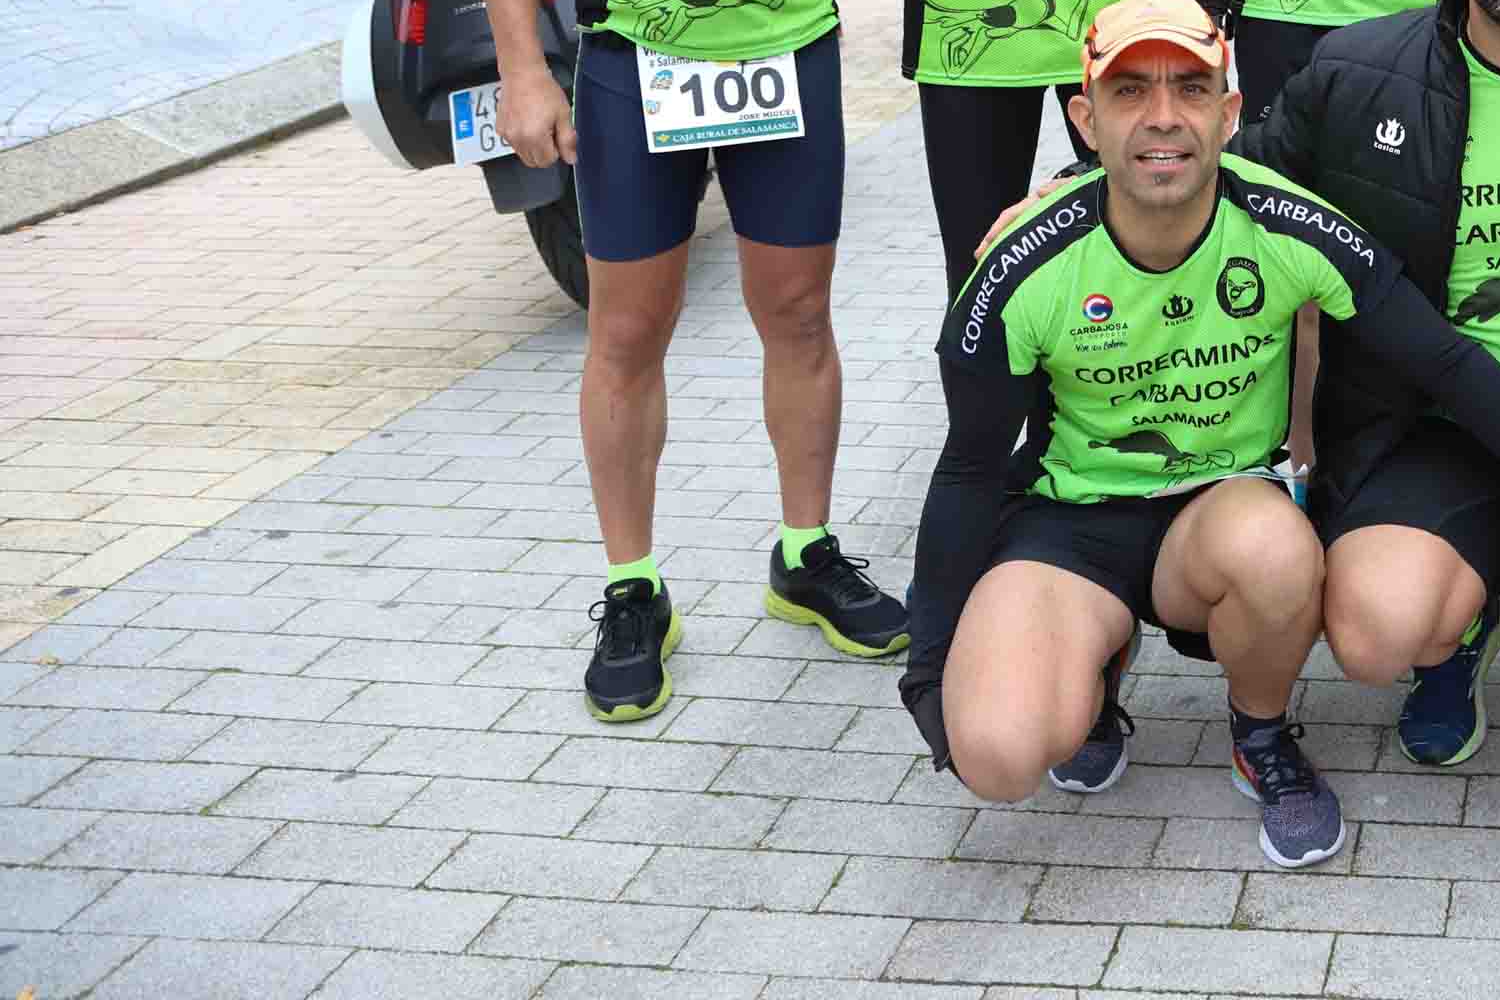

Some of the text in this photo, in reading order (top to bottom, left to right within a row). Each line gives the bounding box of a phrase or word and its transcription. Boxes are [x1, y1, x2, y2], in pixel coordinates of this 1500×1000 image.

[657, 56, 706, 67] Salama
[680, 67, 785, 117] 100
[672, 134, 694, 143] CAJA
[696, 131, 725, 141] RURAL
[739, 121, 798, 134] SALAMANCA
[1247, 194, 1376, 268] CARBAJOSA
[961, 199, 1089, 354] CORRECAMINOS
[1070, 322, 1128, 336] CARBAJOSA
[1074, 333, 1276, 385] CORRECAMINOS
[1110, 370, 1258, 407] CARBAJOSA
[1132, 410, 1231, 428] SALAMANCA
